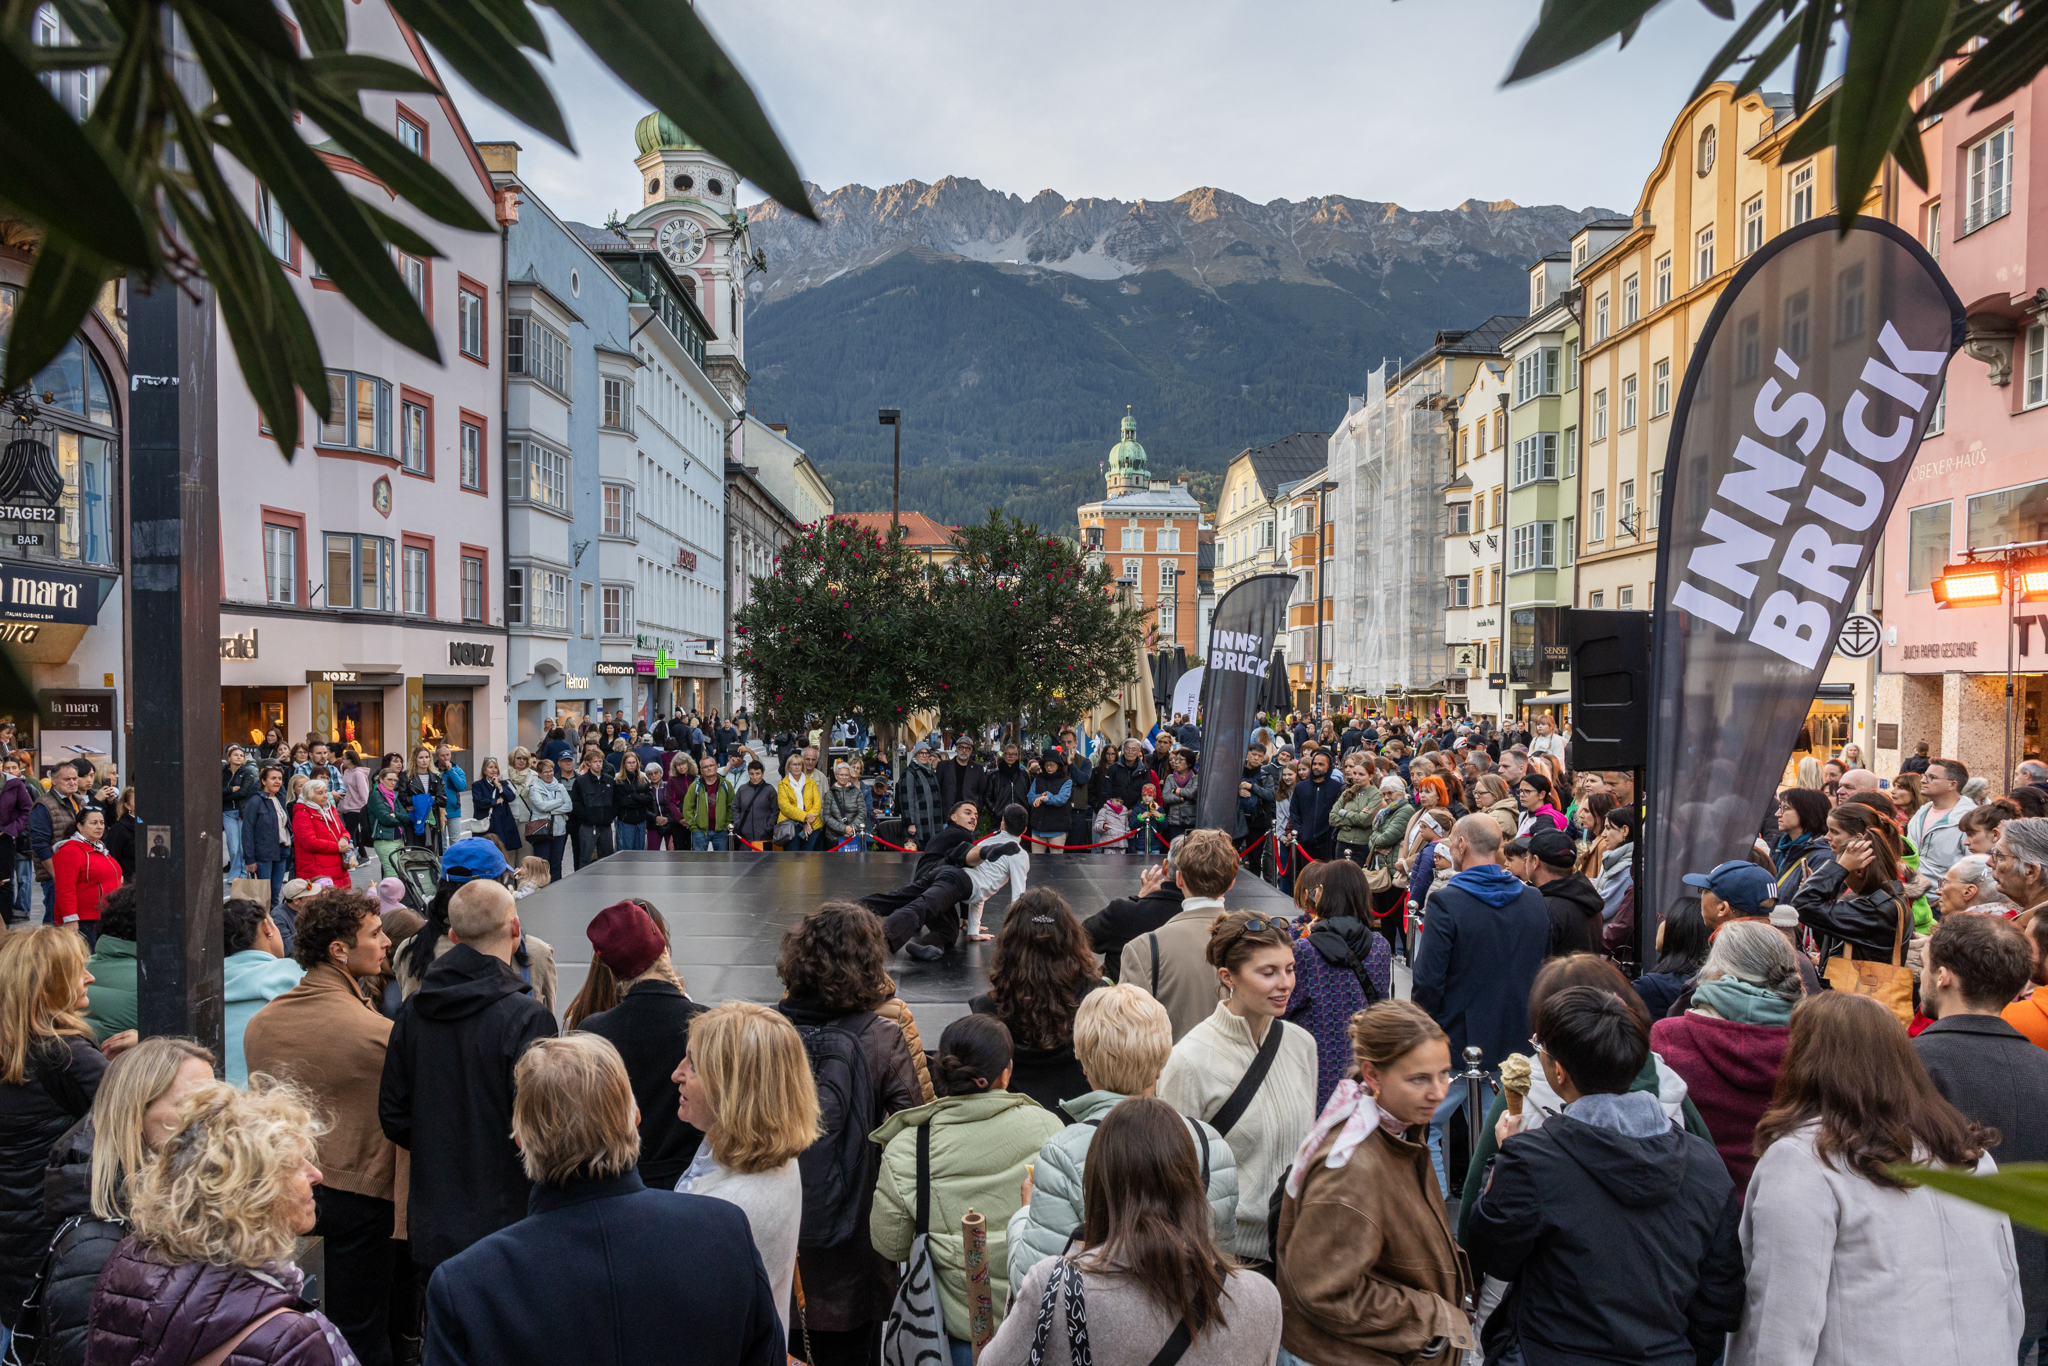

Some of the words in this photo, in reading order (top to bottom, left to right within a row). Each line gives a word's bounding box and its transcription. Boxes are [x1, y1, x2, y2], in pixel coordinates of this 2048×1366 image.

[1911, 448, 1987, 482] OBEXER-HAUS
[1672, 347, 1827, 635] INNS'
[1748, 320, 1948, 670] BRUCK
[0, 506, 56, 521] STAGE12
[17, 535, 38, 545] BAR
[1212, 629, 1262, 653] INNS'
[1544, 646, 1568, 655] SENSEI
[1904, 644, 1919, 660] BUCH
[1920, 643, 1940, 659] PAPIER
[1941, 641, 1978, 659] GESCHENKE
[449, 641, 494, 667] NORZ
[1210, 650, 1269, 678] BRUCK
[322, 671, 356, 682] NORZ
[51, 701, 62, 713] la
[65, 703, 99, 713] mara
[316, 694, 329, 744] NO
[410, 694, 420, 751] NOR
